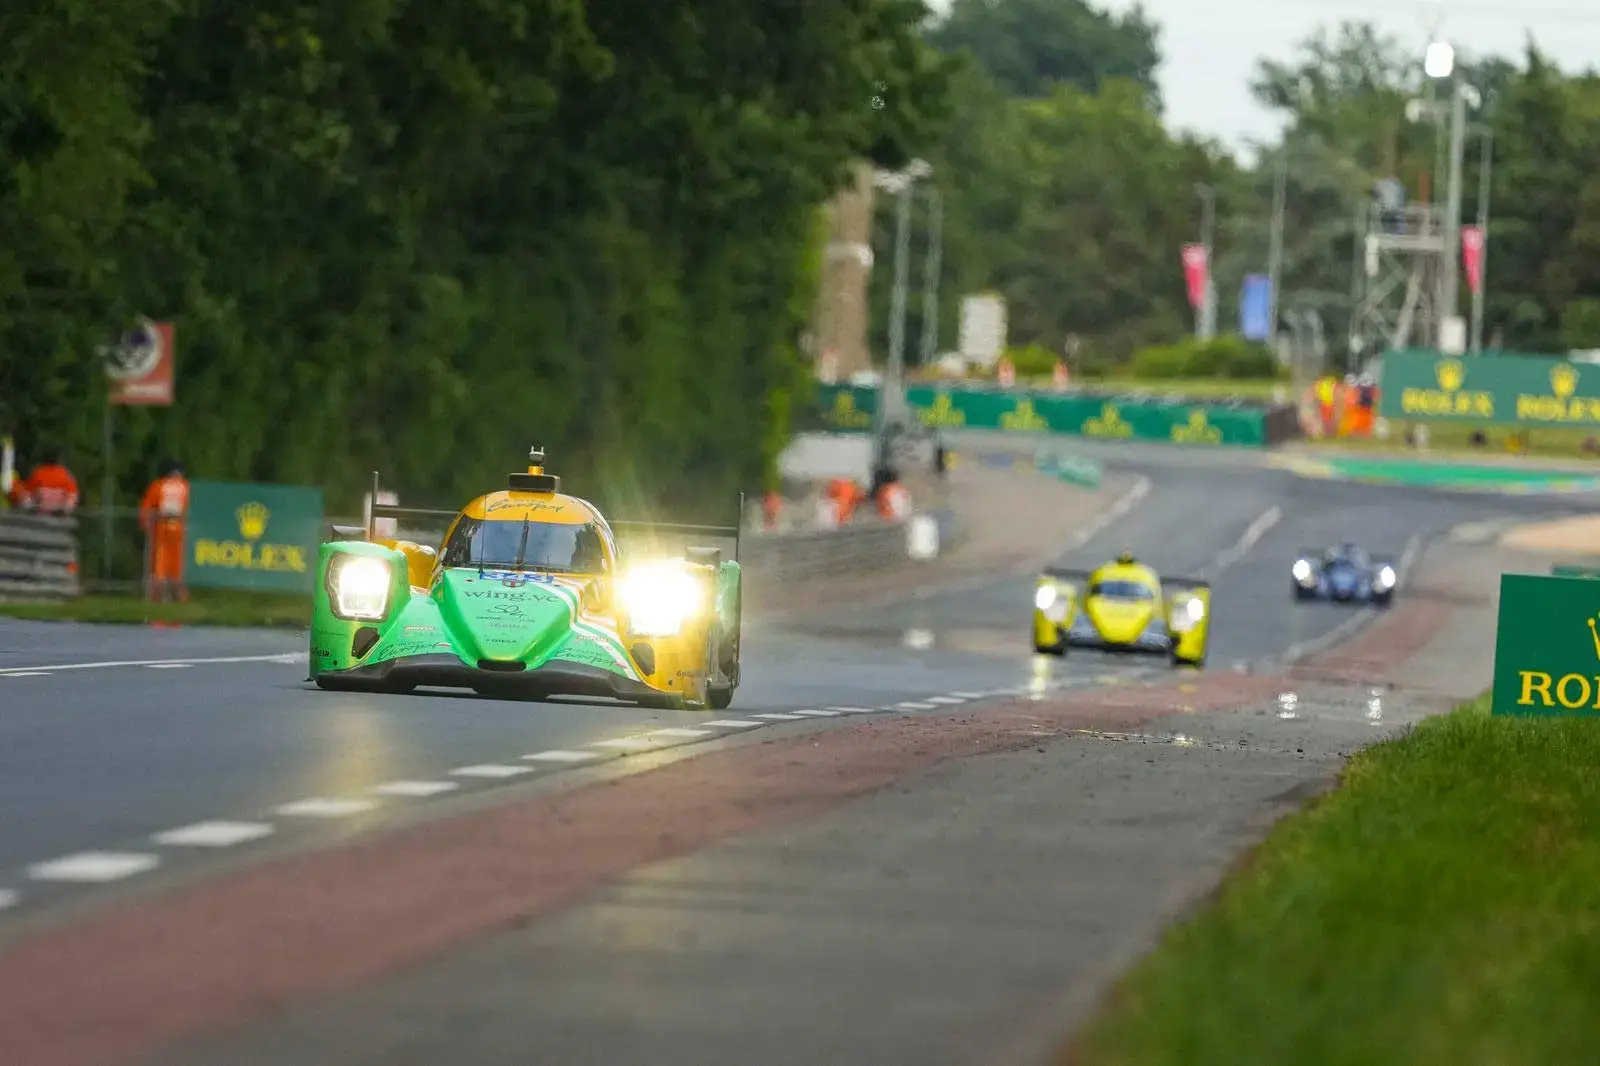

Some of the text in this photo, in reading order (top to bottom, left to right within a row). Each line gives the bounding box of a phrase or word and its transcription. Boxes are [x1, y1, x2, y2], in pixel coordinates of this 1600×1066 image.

[1401, 388, 1494, 417] ROLEX
[195, 540, 307, 571] ROLEX
[464, 591, 559, 602] wing.vc
[1517, 671, 1600, 709] RO
